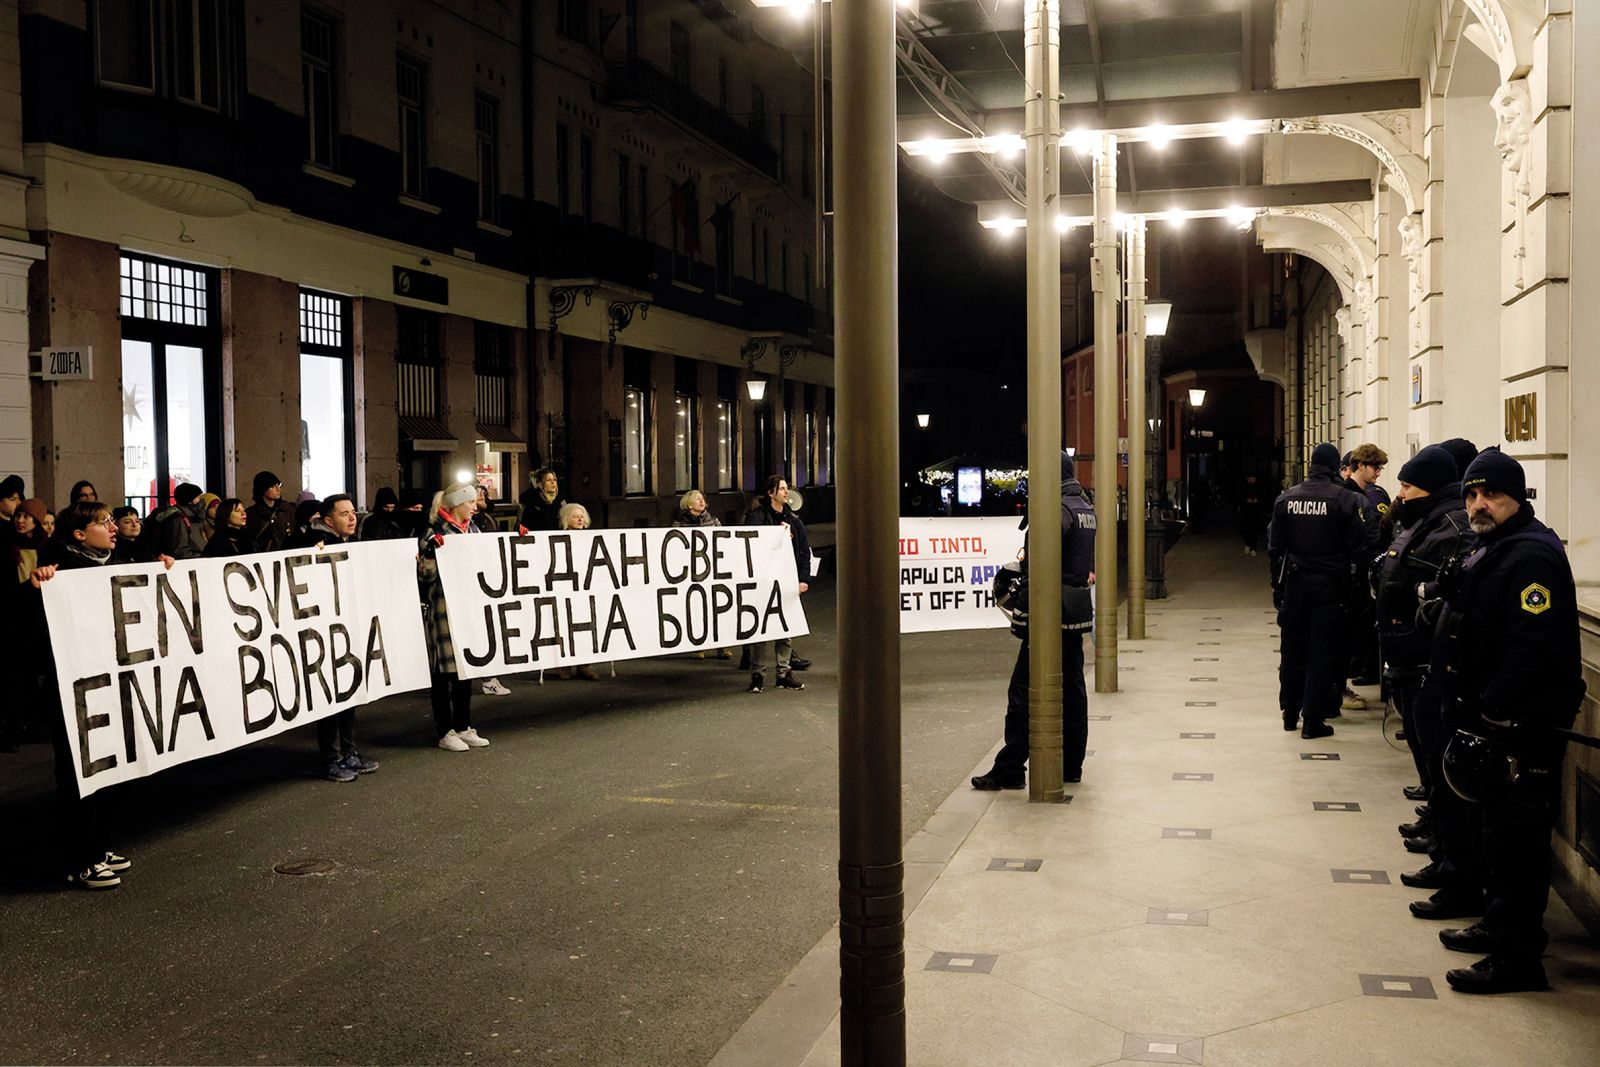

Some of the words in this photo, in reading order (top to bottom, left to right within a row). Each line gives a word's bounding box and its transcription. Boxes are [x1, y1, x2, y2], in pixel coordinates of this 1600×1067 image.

[1287, 500, 1328, 516] POLICIJA
[477, 532, 650, 599] ЈЕДАН
[660, 529, 759, 585] СВЕТ
[898, 538, 919, 555] IO
[928, 536, 987, 555] TINTO,
[901, 567, 938, 585] АРШ
[943, 566, 965, 584] СА
[970, 565, 1000, 585] ДР
[110, 569, 204, 666] EN
[222, 551, 349, 642] SVET
[463, 593, 636, 667] ЈЕДНА
[657, 579, 789, 648] БОРБА
[900, 592, 923, 611] ET
[930, 590, 966, 610] OFF
[972, 589, 997, 608] TH
[73, 666, 215, 779] ENA
[238, 615, 391, 734] BORBA
